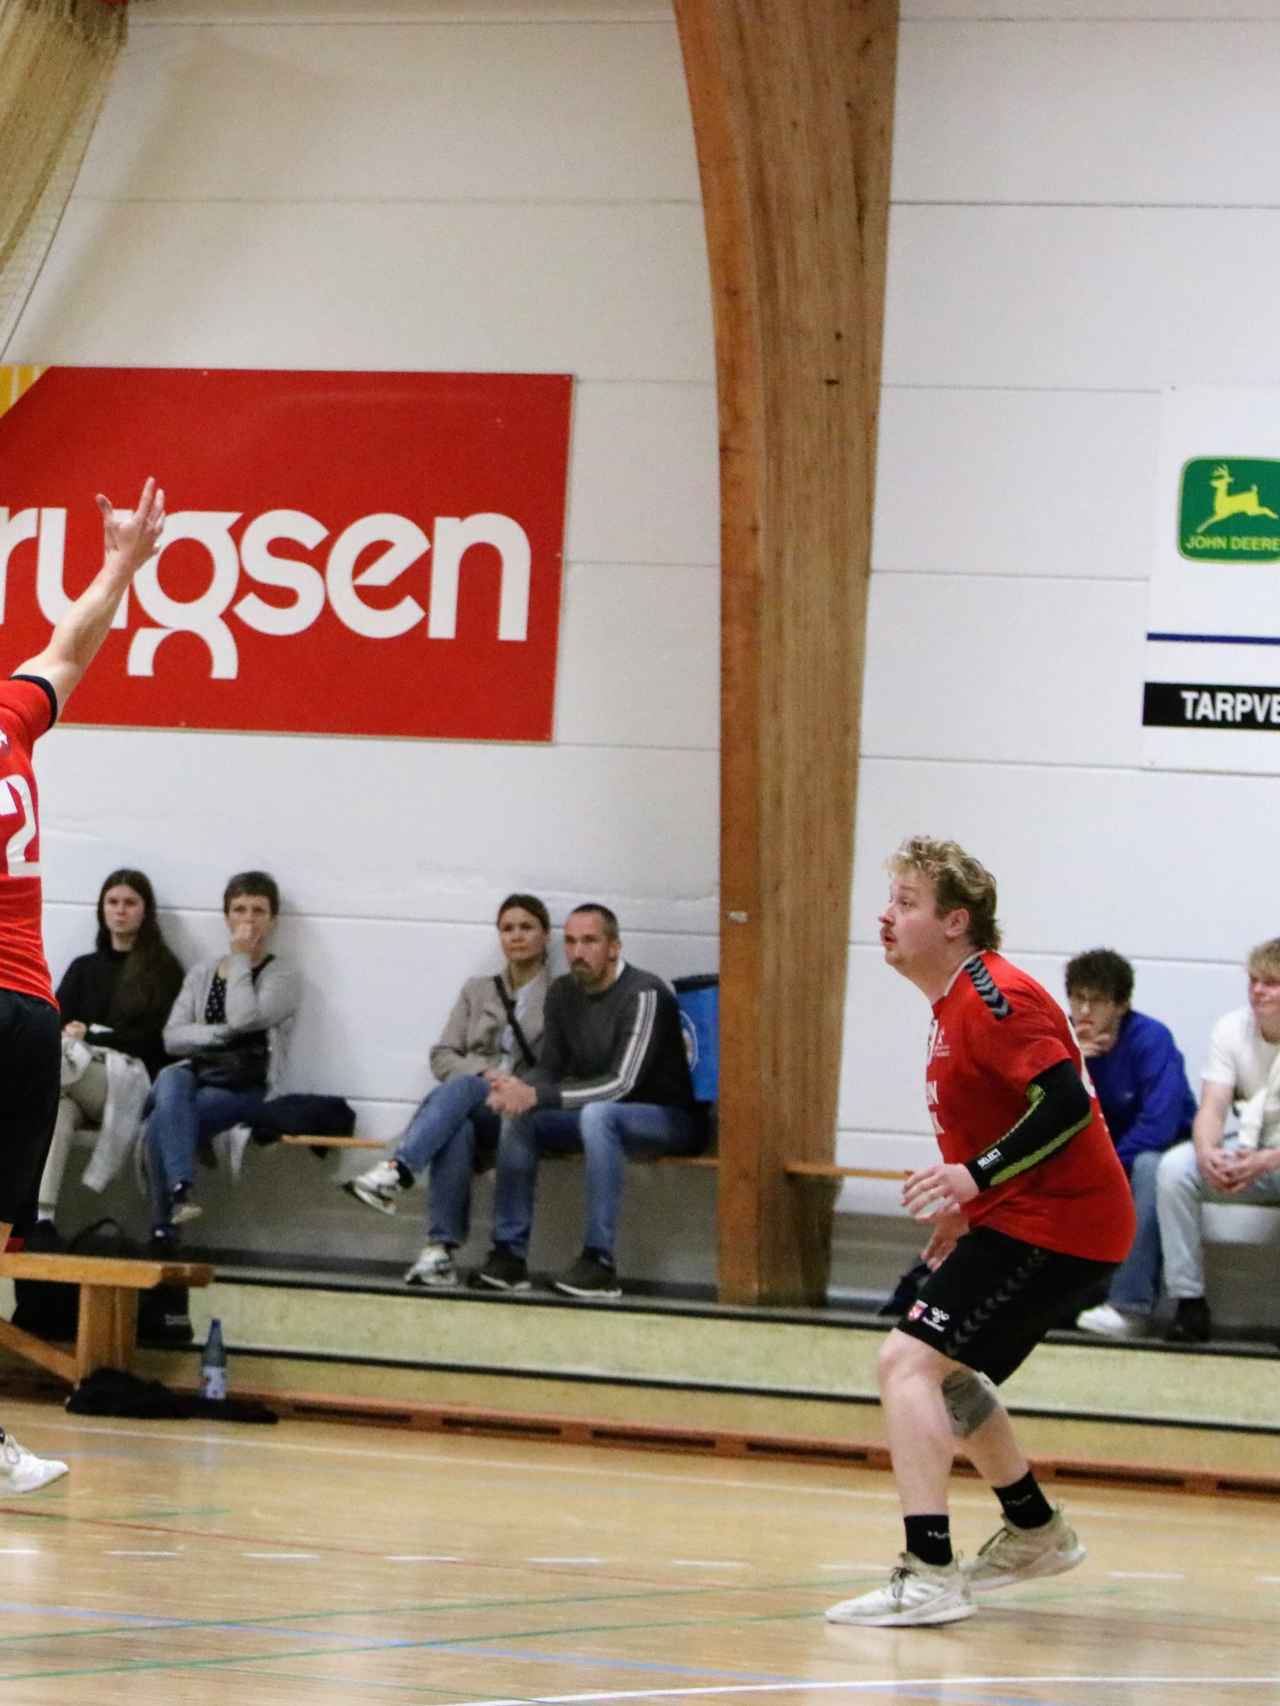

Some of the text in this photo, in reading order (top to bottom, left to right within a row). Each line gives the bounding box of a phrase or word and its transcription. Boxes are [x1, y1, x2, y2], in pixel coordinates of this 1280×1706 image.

[1185, 534, 1280, 552] JOHN DEERE
[1180, 690, 1280, 724] TARPVE
